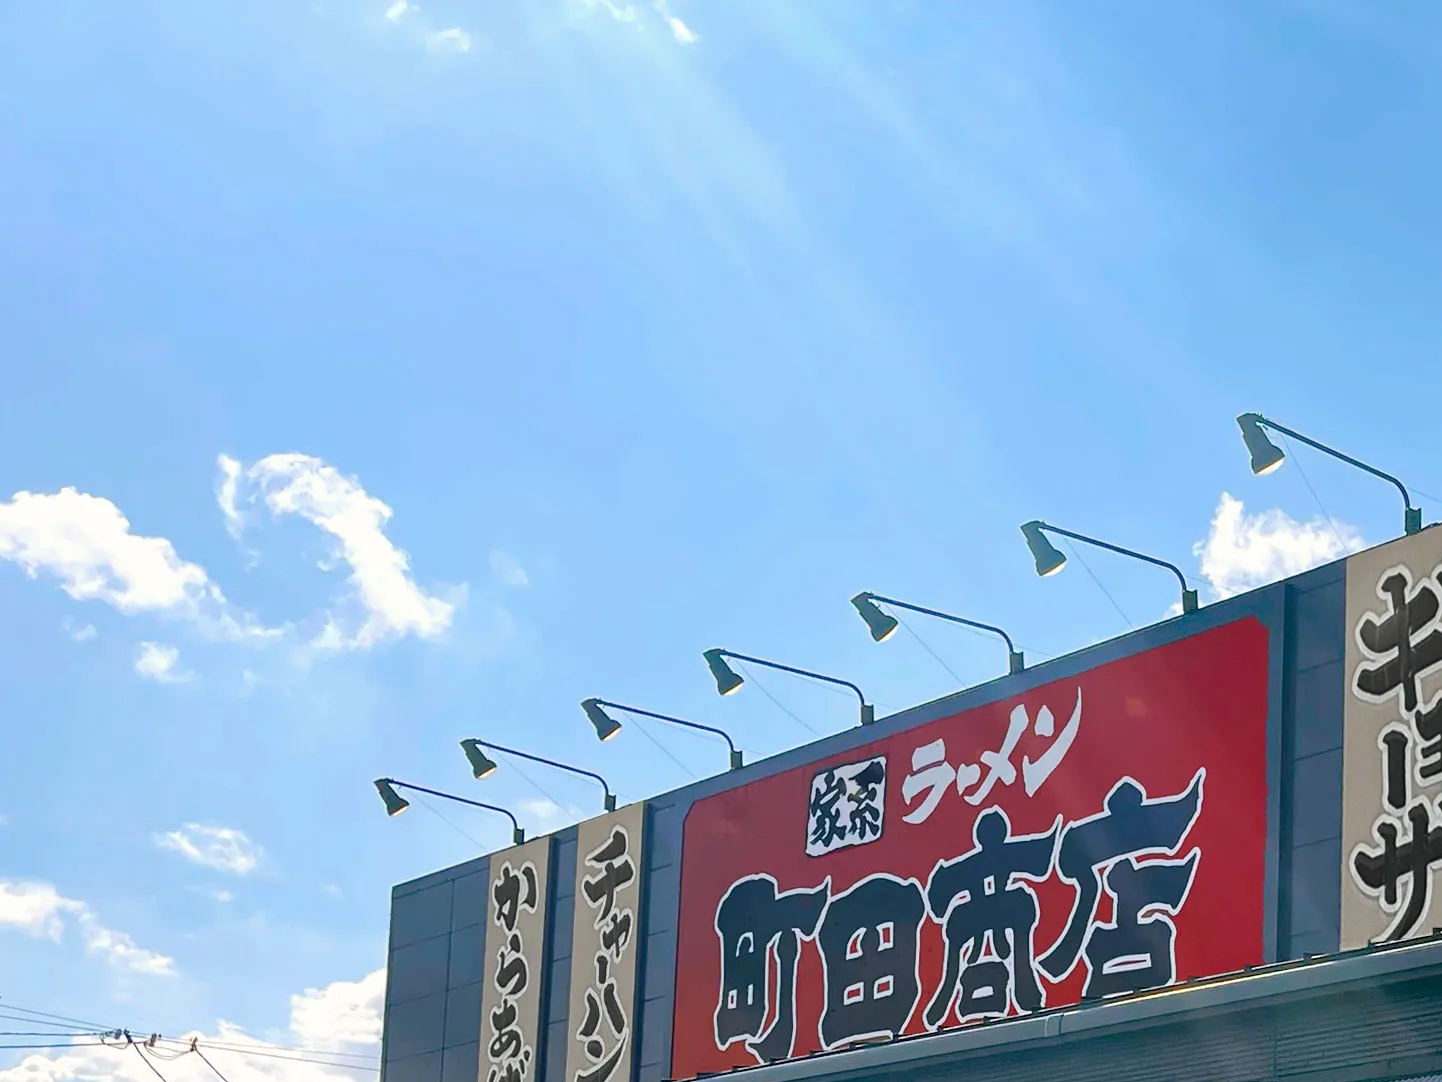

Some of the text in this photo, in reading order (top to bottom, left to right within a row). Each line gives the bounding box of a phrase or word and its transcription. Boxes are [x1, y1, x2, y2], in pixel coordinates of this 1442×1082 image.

[809, 686, 1083, 849] 家系 ラーメン
[714, 767, 1207, 1065] 町田商店
